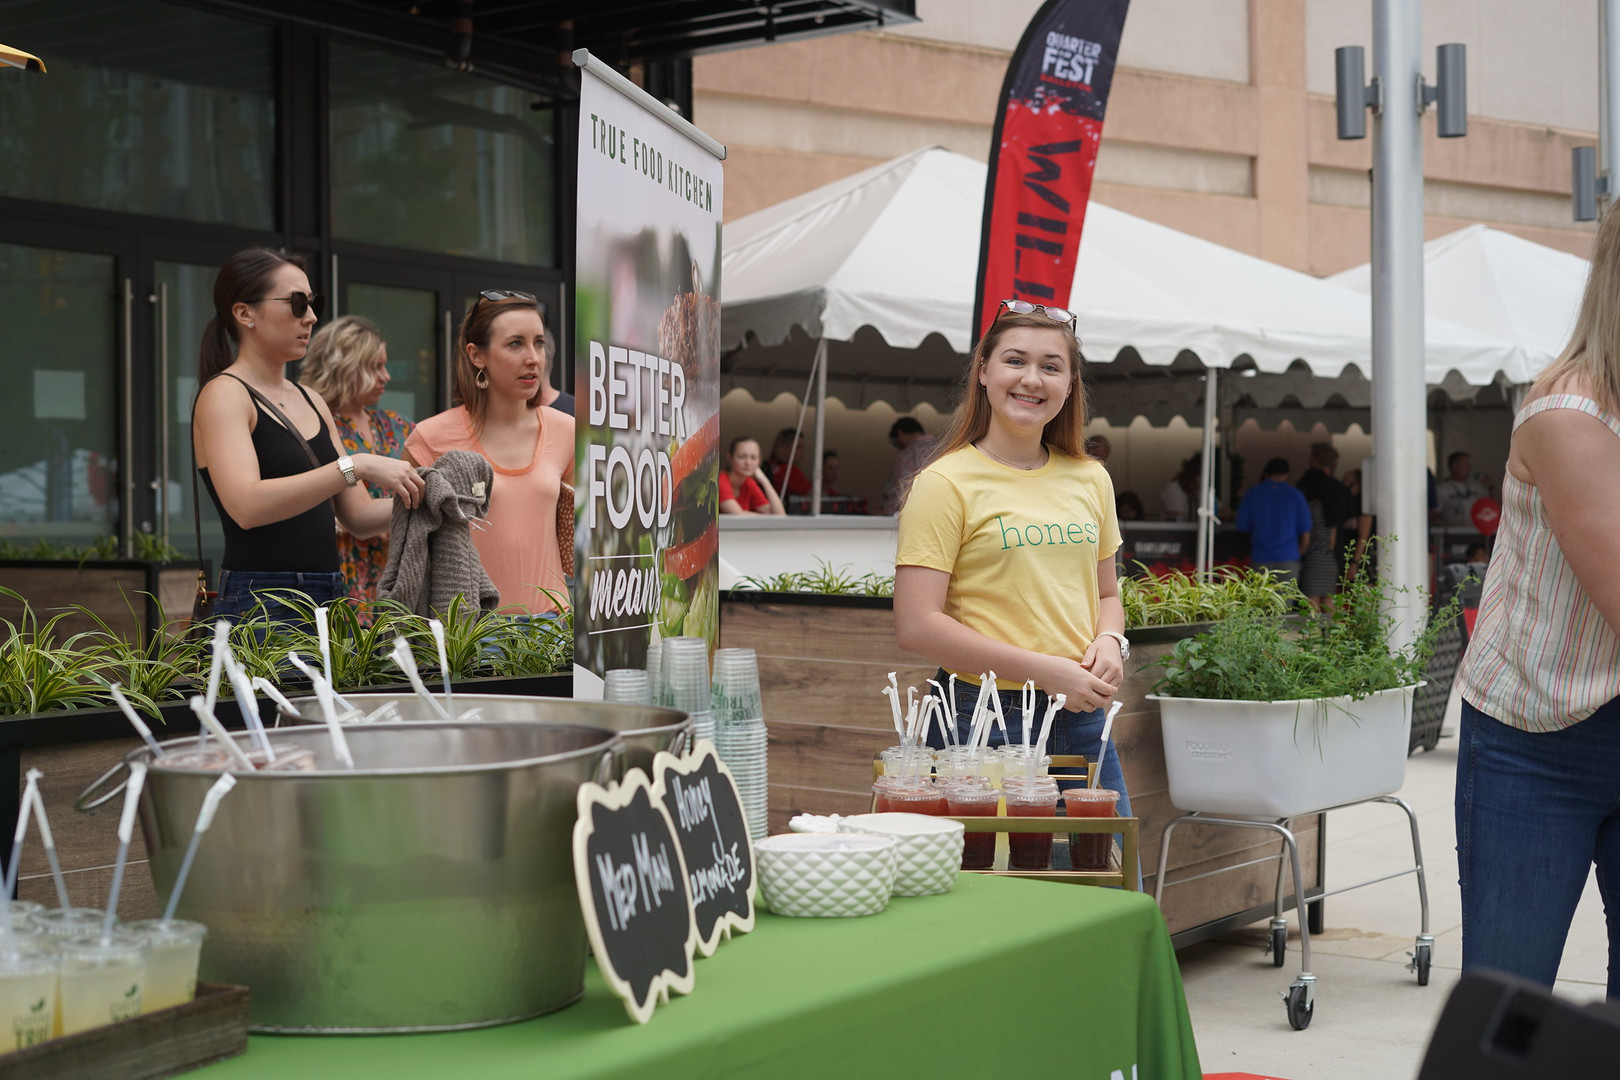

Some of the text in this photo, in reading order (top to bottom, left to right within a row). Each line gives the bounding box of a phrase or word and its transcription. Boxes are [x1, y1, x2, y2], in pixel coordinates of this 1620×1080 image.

[1042, 46, 1099, 85] FEST
[1046, 31, 1102, 58] QUARTER
[591, 113, 712, 213] TRUE FOOD KITCHEN
[589, 340, 687, 438] BETTER
[589, 444, 673, 530] FOOD
